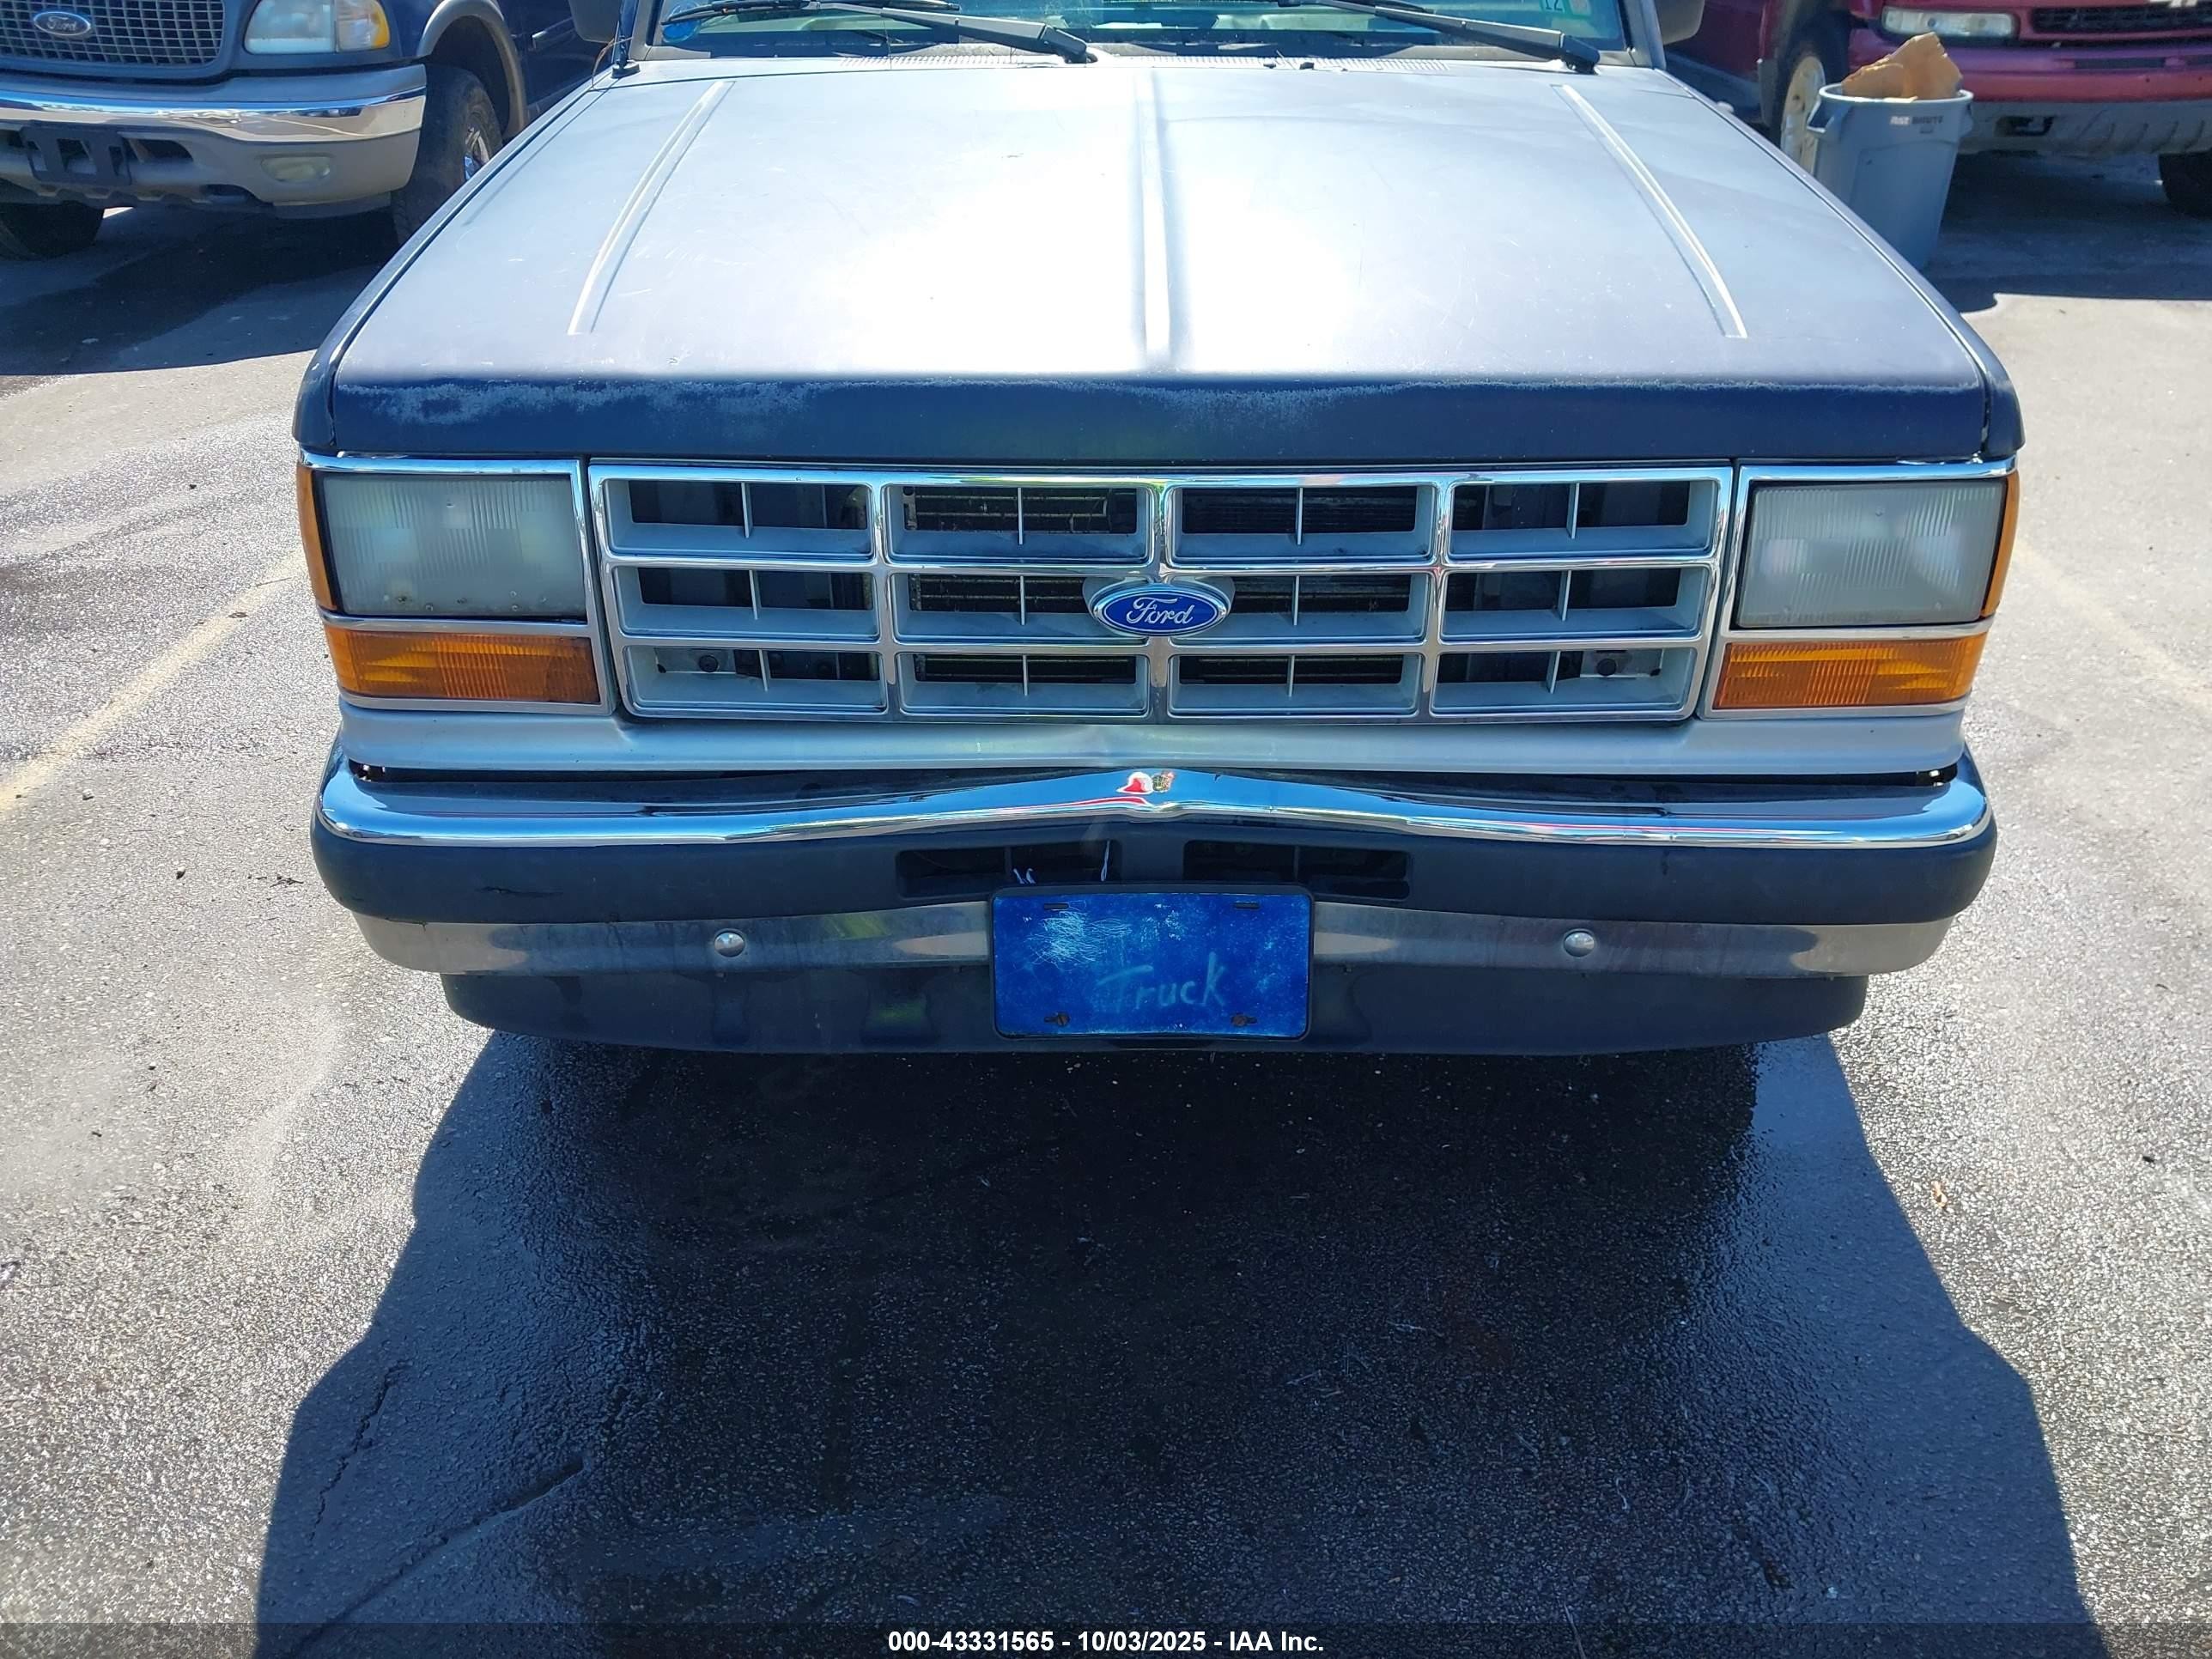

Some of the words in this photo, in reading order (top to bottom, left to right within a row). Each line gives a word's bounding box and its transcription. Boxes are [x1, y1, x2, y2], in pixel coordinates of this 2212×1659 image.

[46, 15, 77, 31] Ford
[1126, 597, 1194, 624] Ford
[1095, 951, 1225, 1013] Truck
